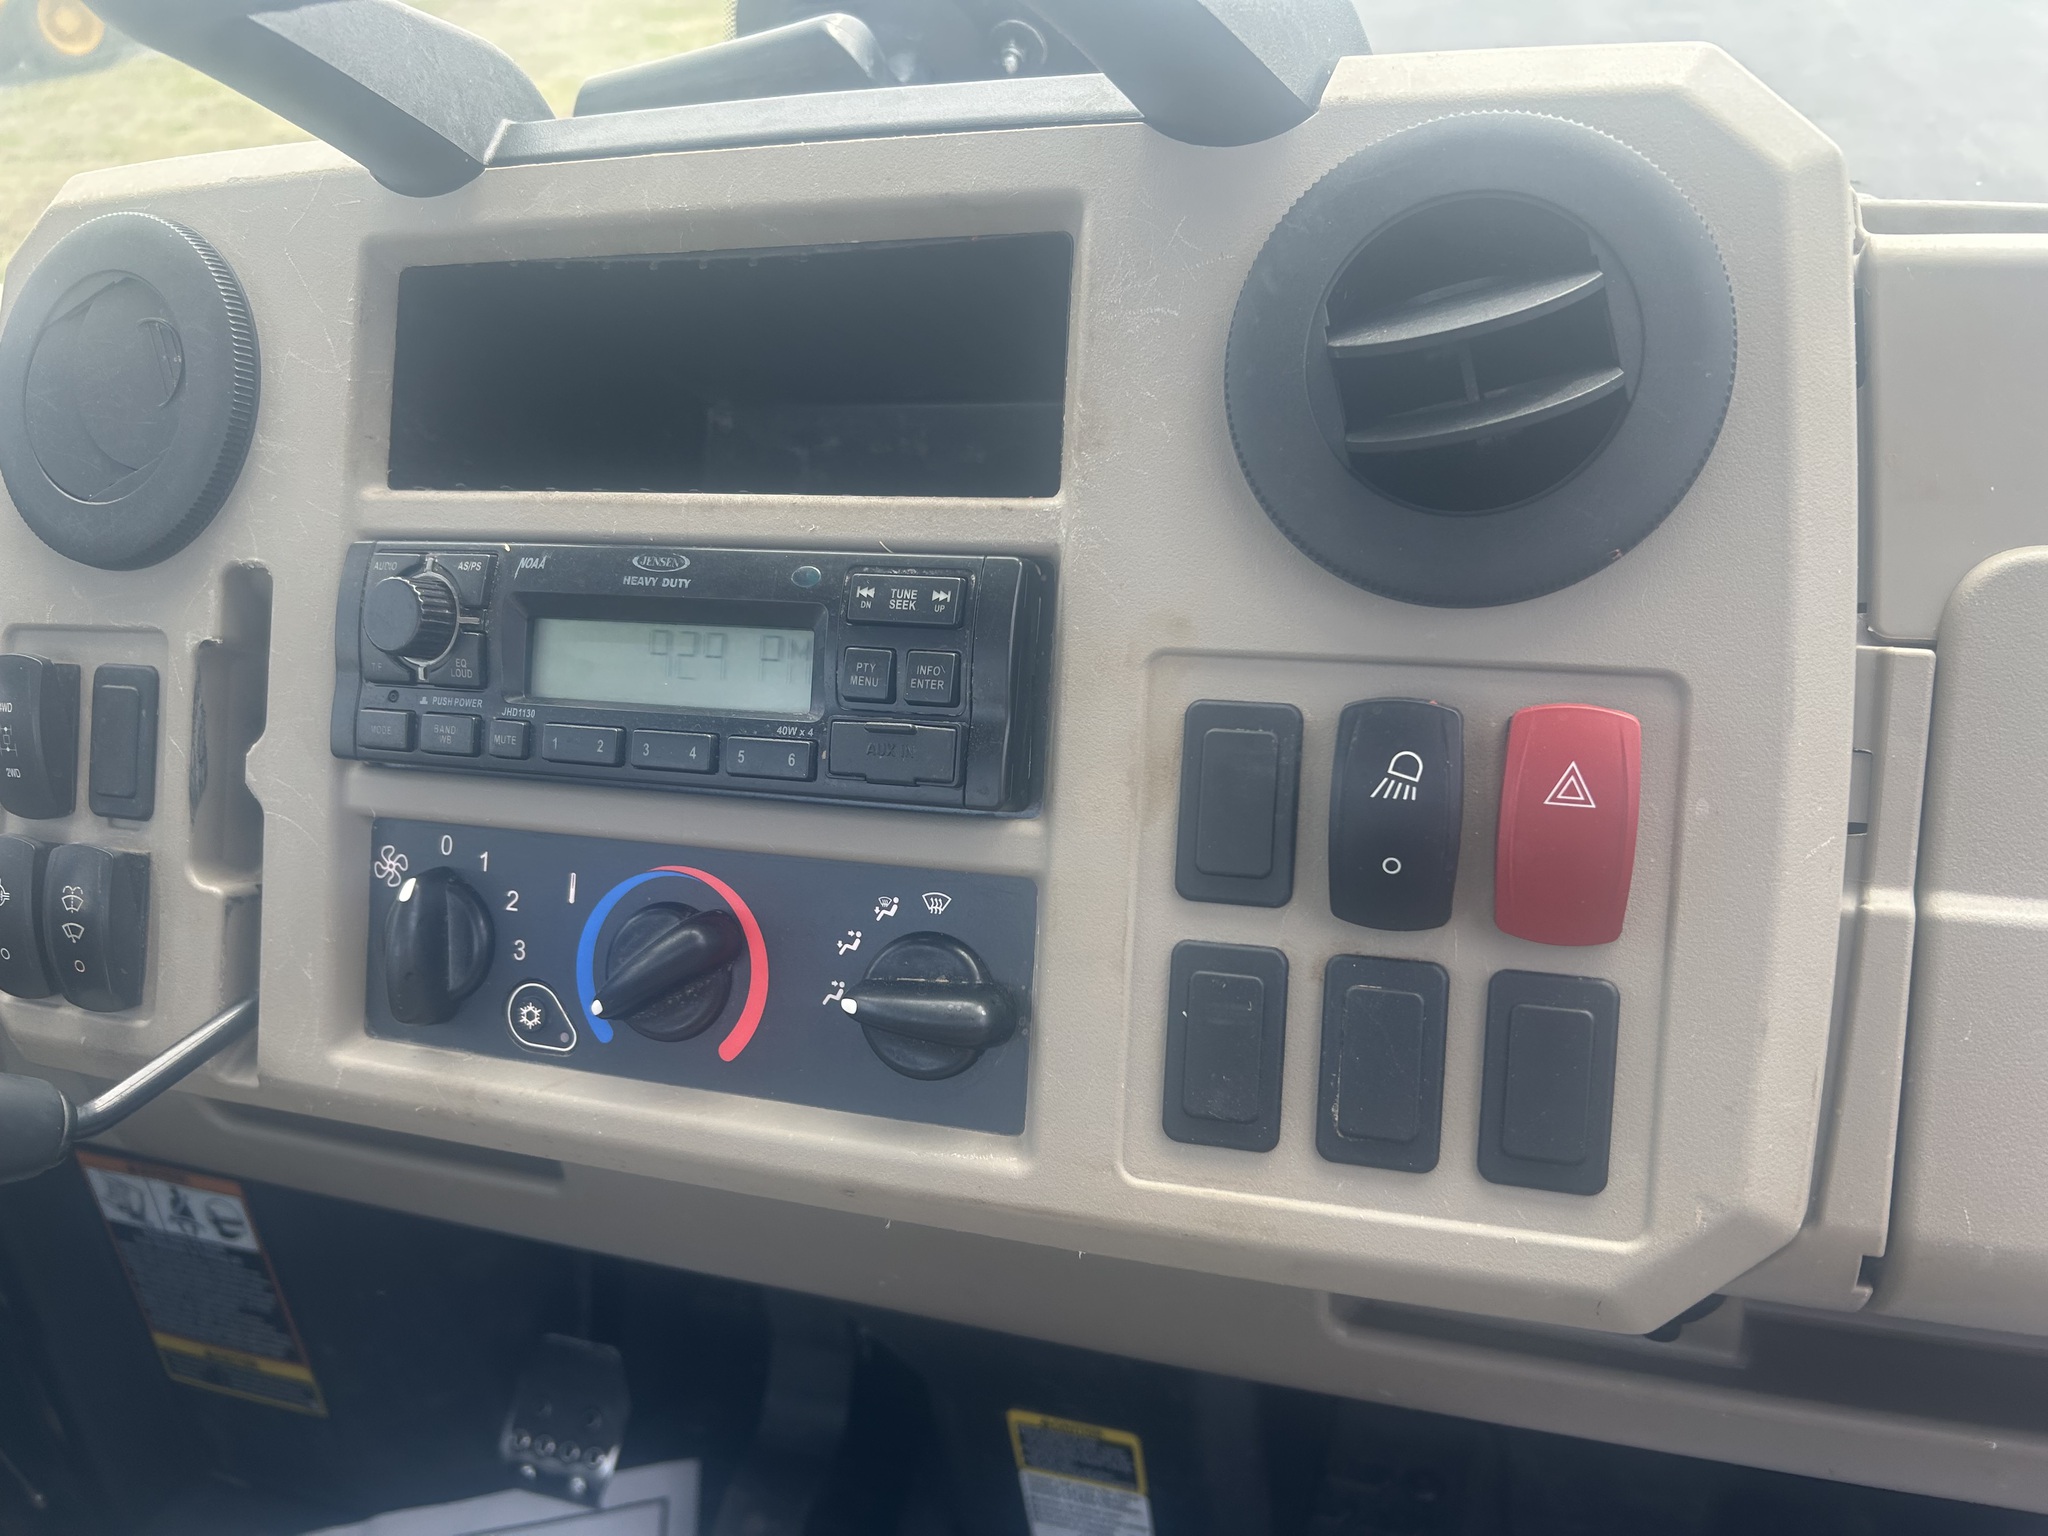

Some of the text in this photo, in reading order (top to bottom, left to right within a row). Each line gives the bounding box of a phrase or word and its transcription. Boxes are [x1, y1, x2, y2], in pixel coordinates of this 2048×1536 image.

[374, 561, 398, 571] AUDIO
[457, 561, 482, 572] AS/PS
[514, 555, 548, 580] NOAA
[640, 555, 680, 568] JENSEN
[623, 575, 692, 589] HEAVY DUTY
[890, 588, 918, 600] TUNE
[860, 600, 872, 609] DN
[888, 600, 917, 611] SEEK
[934, 604, 946, 613] UP
[455, 658, 467, 669] EQ
[856, 662, 877, 673] PTY
[450, 668, 473, 679] LOUD
[916, 665, 941, 676] INFO
[850, 675, 879, 688] MENU
[910, 678, 945, 690] ENTER
[432, 696, 483, 709] PUSH POWER
[501, 707, 536, 718] JHD1130
[370, 725, 392, 735] MODE
[433, 724, 457, 735] BAND
[776, 726, 799, 737] 40W
[807, 728, 814, 737] 4
[439, 735, 452, 744] WB
[493, 734, 517, 745] MUTE
[552, 738, 604, 753] 1 2
[642, 742, 697, 759] 3 4
[865, 742, 914, 759] AUX IN
[737, 749, 796, 767] 5 6
[5, 767, 21, 779] 2WD
[440, 834, 453, 855] 0
[479, 851, 489, 872] 1
[505, 890, 519, 912] 2
[513, 939, 526, 961] 3
